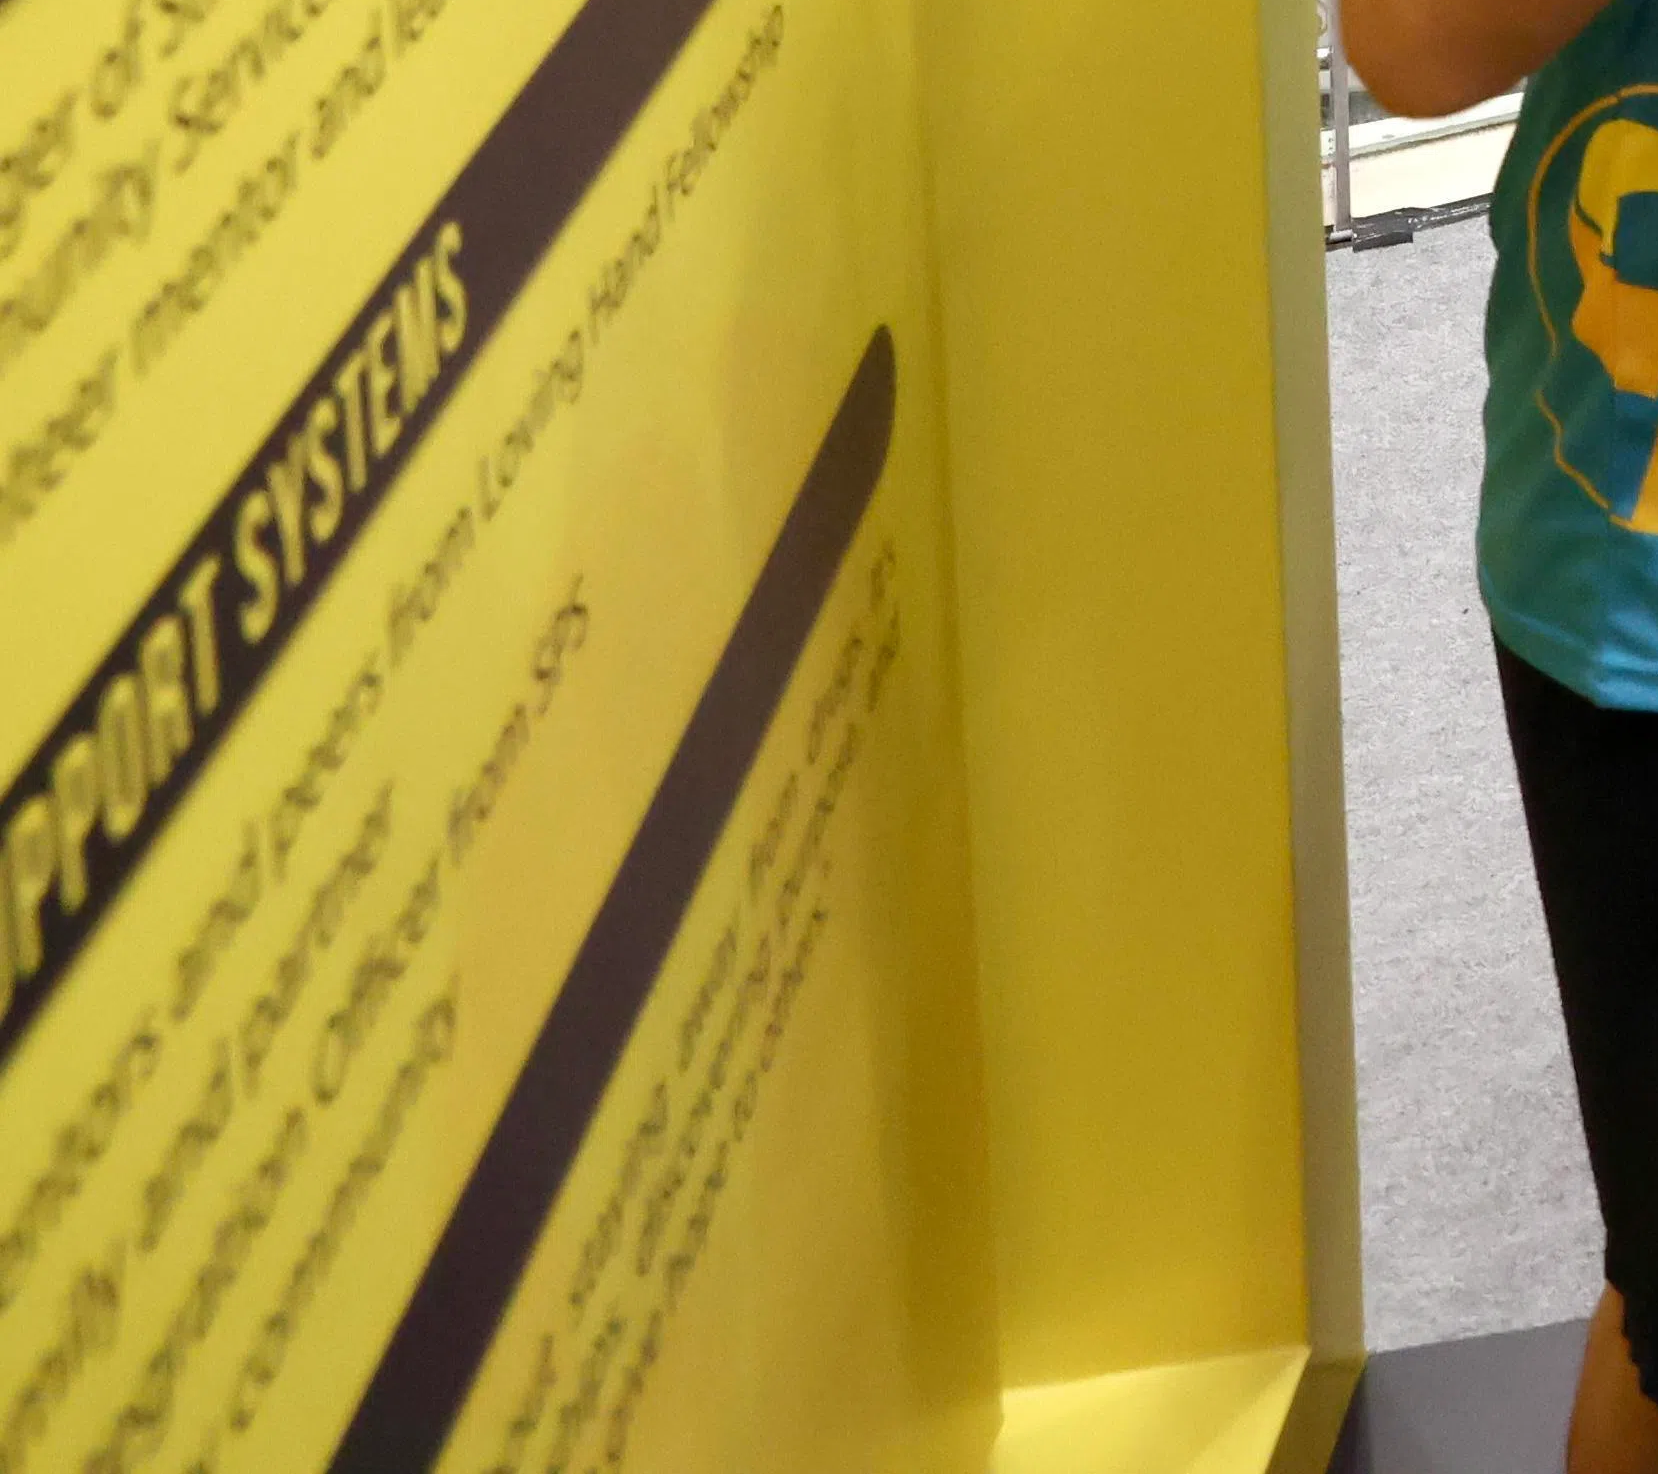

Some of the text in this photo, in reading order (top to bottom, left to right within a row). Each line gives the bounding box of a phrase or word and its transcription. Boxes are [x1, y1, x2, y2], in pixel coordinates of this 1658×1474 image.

[129, 129, 302, 378] mentor
[312, 5, 388, 161] and
[0, 220, 468, 988] PPORT SYSTEMS
[173, 817, 263, 1025] and
[388, 506, 476, 670] from
[476, 327, 585, 523] Loving
[588, 182, 663, 349] Hand
[666, 3, 785, 223] Fellowship
[448, 701, 530, 868] from
